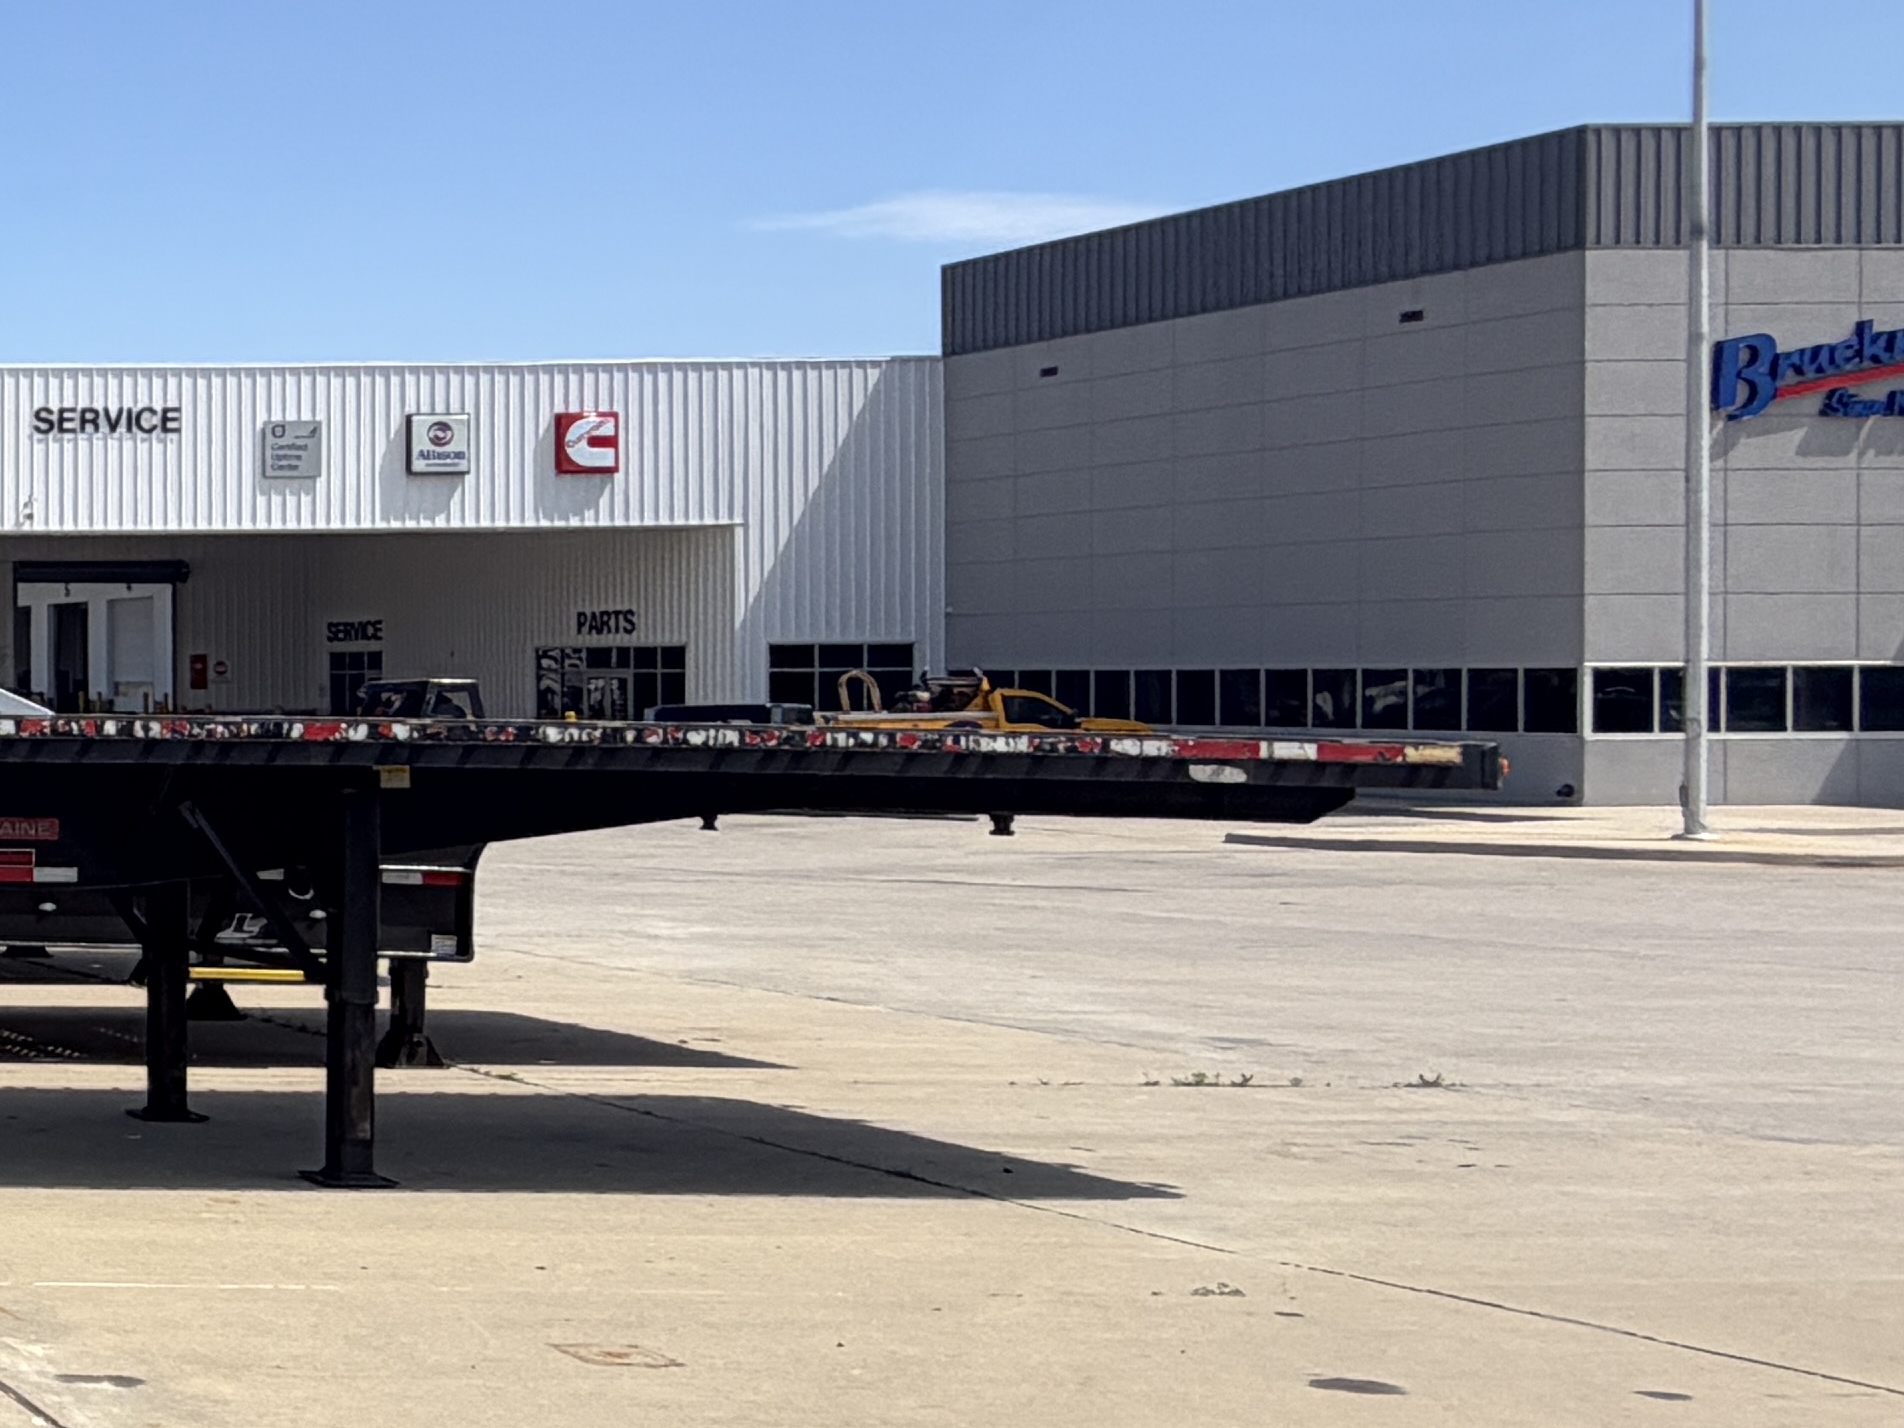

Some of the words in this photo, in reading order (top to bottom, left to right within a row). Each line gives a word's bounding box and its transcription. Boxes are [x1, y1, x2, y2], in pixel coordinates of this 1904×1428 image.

[32, 406, 182, 435] SERVICE
[327, 619, 383, 643] SERVICE
[576, 609, 636, 636] PARTS
